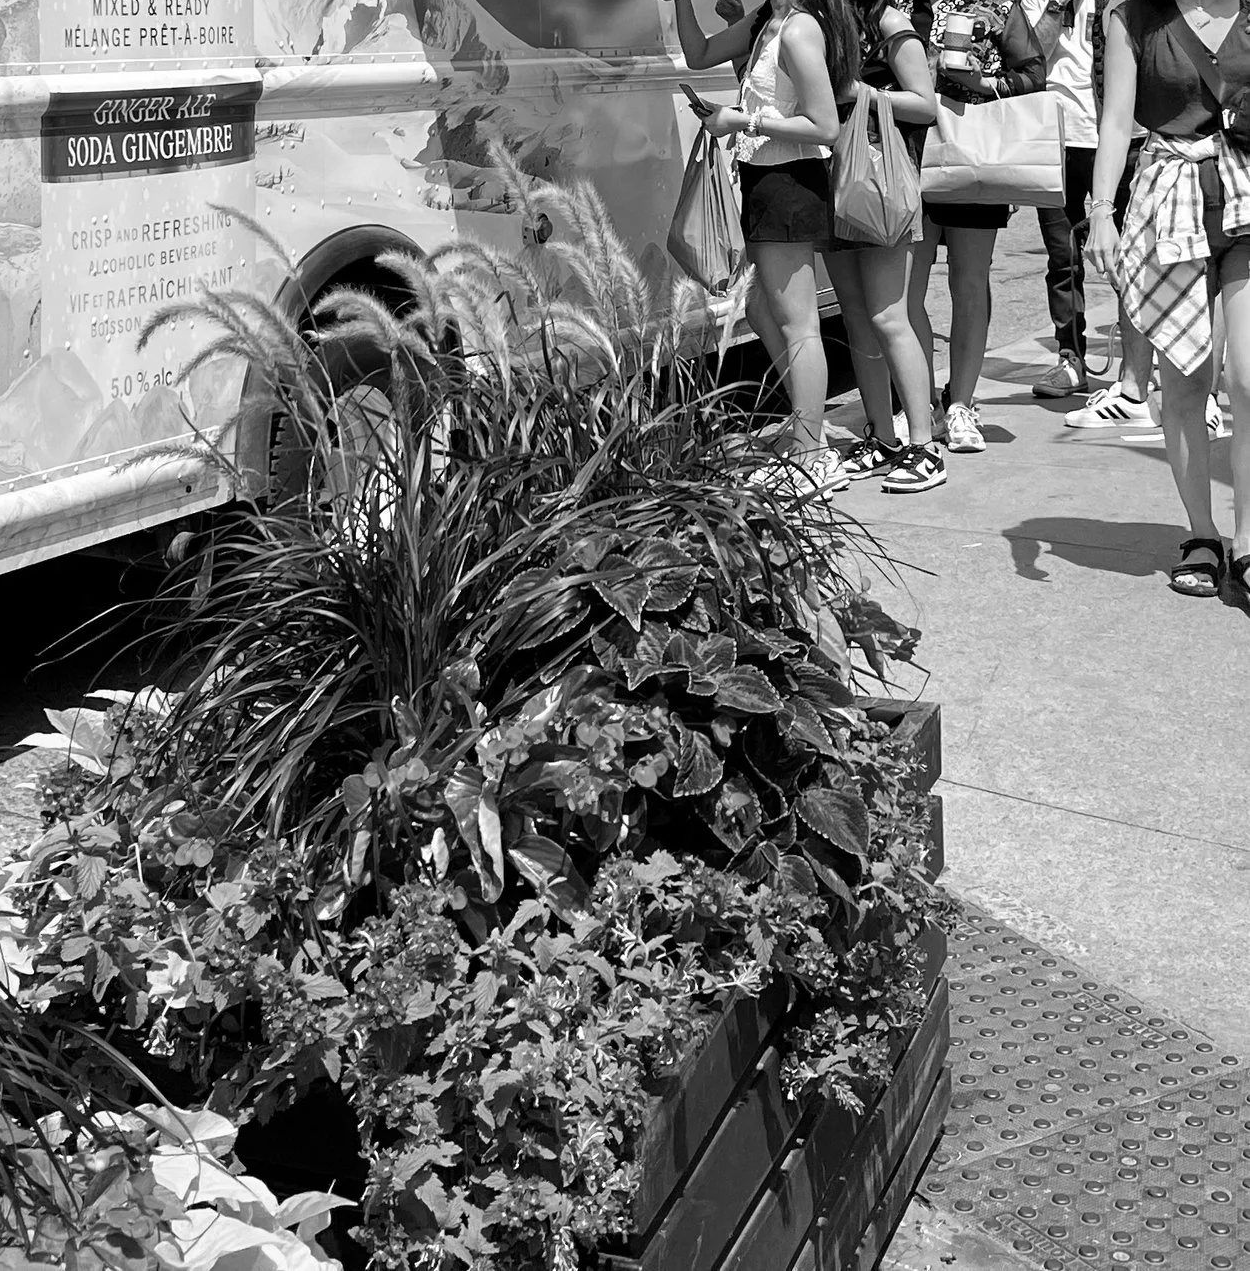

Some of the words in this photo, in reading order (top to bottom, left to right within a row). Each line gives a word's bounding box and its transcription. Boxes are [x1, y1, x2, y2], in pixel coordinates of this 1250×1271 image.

[64, 24, 131, 48] MÉLANGE
[139, 23, 234, 46] PRÊT-À-BOIRE
[93, 96, 175, 125] GINGER
[176, 93, 217, 119] ALE
[67, 135, 117, 167] SODA
[122, 124, 233, 163] GINGEMBRE
[71, 228, 112, 251] CRISP
[116, 228, 138, 243] AND
[141, 212, 232, 242] REFRESHING
[88, 252, 155, 276] ALCOHOLIC
[160, 241, 218, 265] BEVERAGE
[70, 293, 90, 313] VIF
[92, 294, 104, 308] ET
[90, 316, 142, 338] BOISSON
